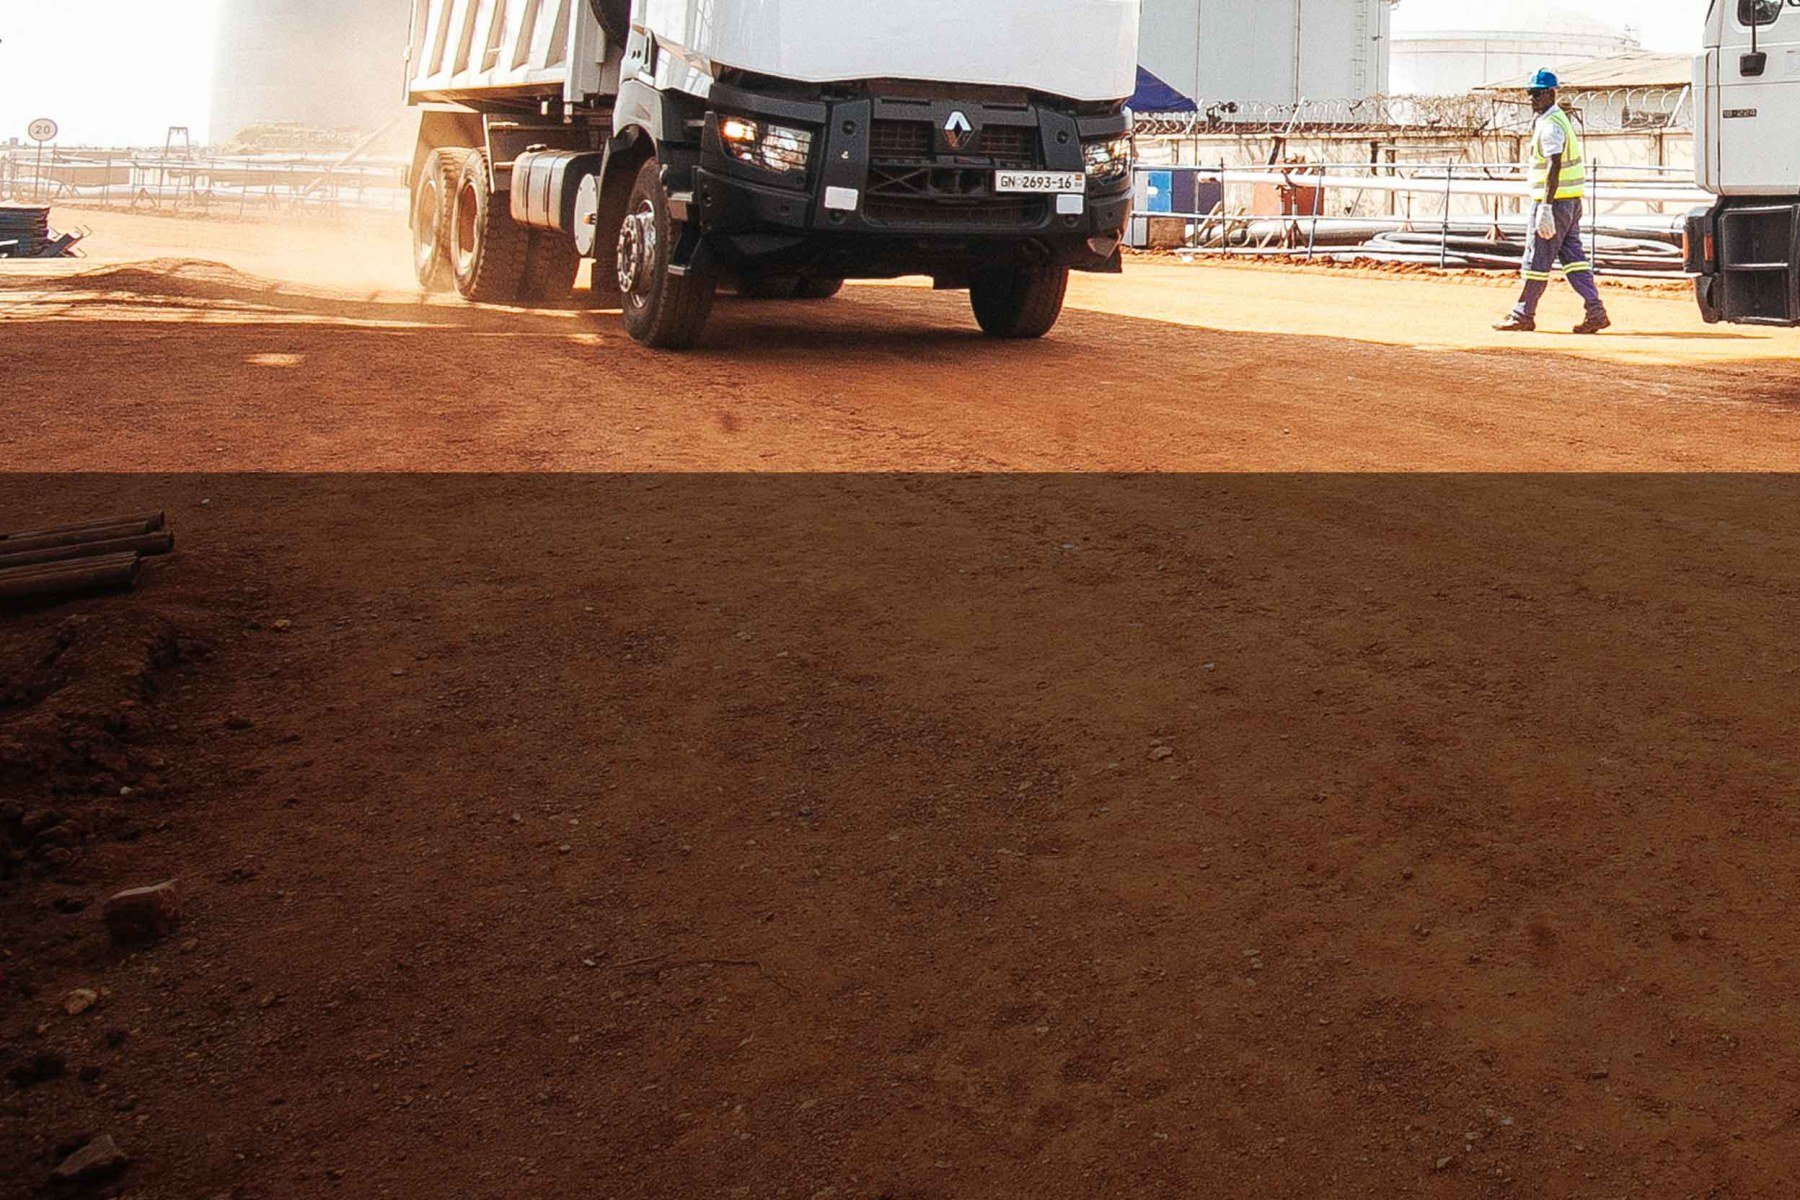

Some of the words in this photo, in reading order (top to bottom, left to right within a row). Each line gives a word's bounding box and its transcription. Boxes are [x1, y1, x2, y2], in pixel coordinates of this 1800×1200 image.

[34, 124, 51, 135] 20
[1000, 175, 1016, 187] GN
[1022, 175, 1072, 189] 2693-16
